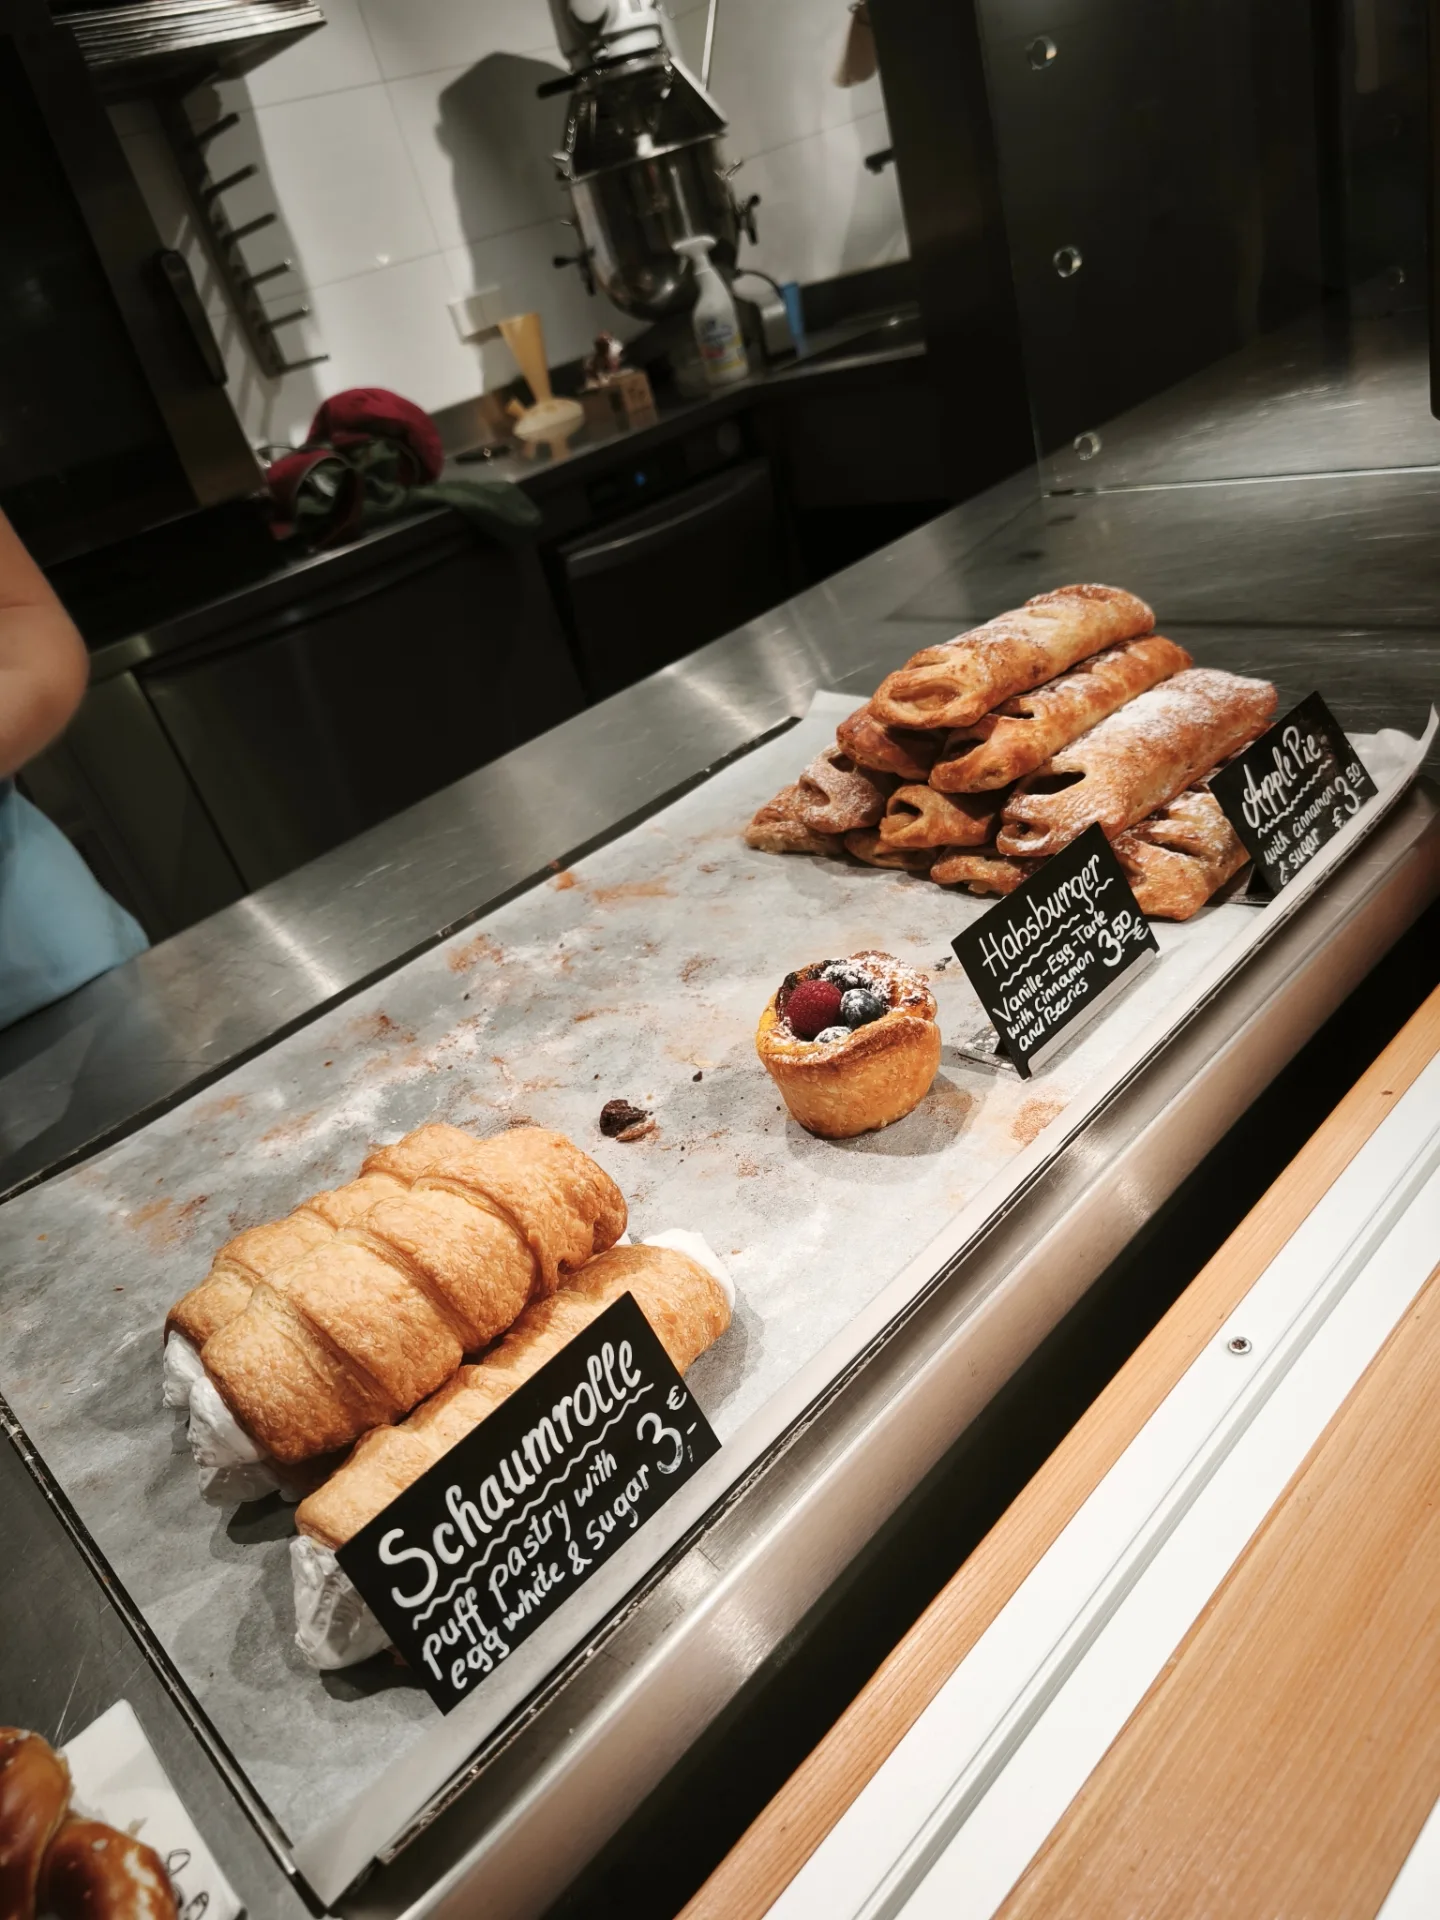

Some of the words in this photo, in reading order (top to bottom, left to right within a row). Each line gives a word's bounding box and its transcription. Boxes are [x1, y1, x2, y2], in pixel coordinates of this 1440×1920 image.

[1242, 746, 1298, 828] Apple
[1283, 726, 1322, 770] Pie
[1263, 830, 1291, 865] with
[1293, 786, 1336, 838] cinnamon
[1288, 828, 1320, 869] sugar
[979, 854, 1099, 977] Habsburger
[1006, 1007, 1035, 1040] with
[1019, 1016, 1046, 1052] and
[378, 1339, 642, 1609] Schaumrolle
[422, 1586, 489, 1681] puff
[488, 1499, 571, 1613] pastry
[573, 1449, 618, 1507] with
[451, 1625, 510, 1690] egg
[502, 1562, 566, 1632] white
[567, 1540, 593, 1576] &
[585, 1463, 649, 1551] sugar
